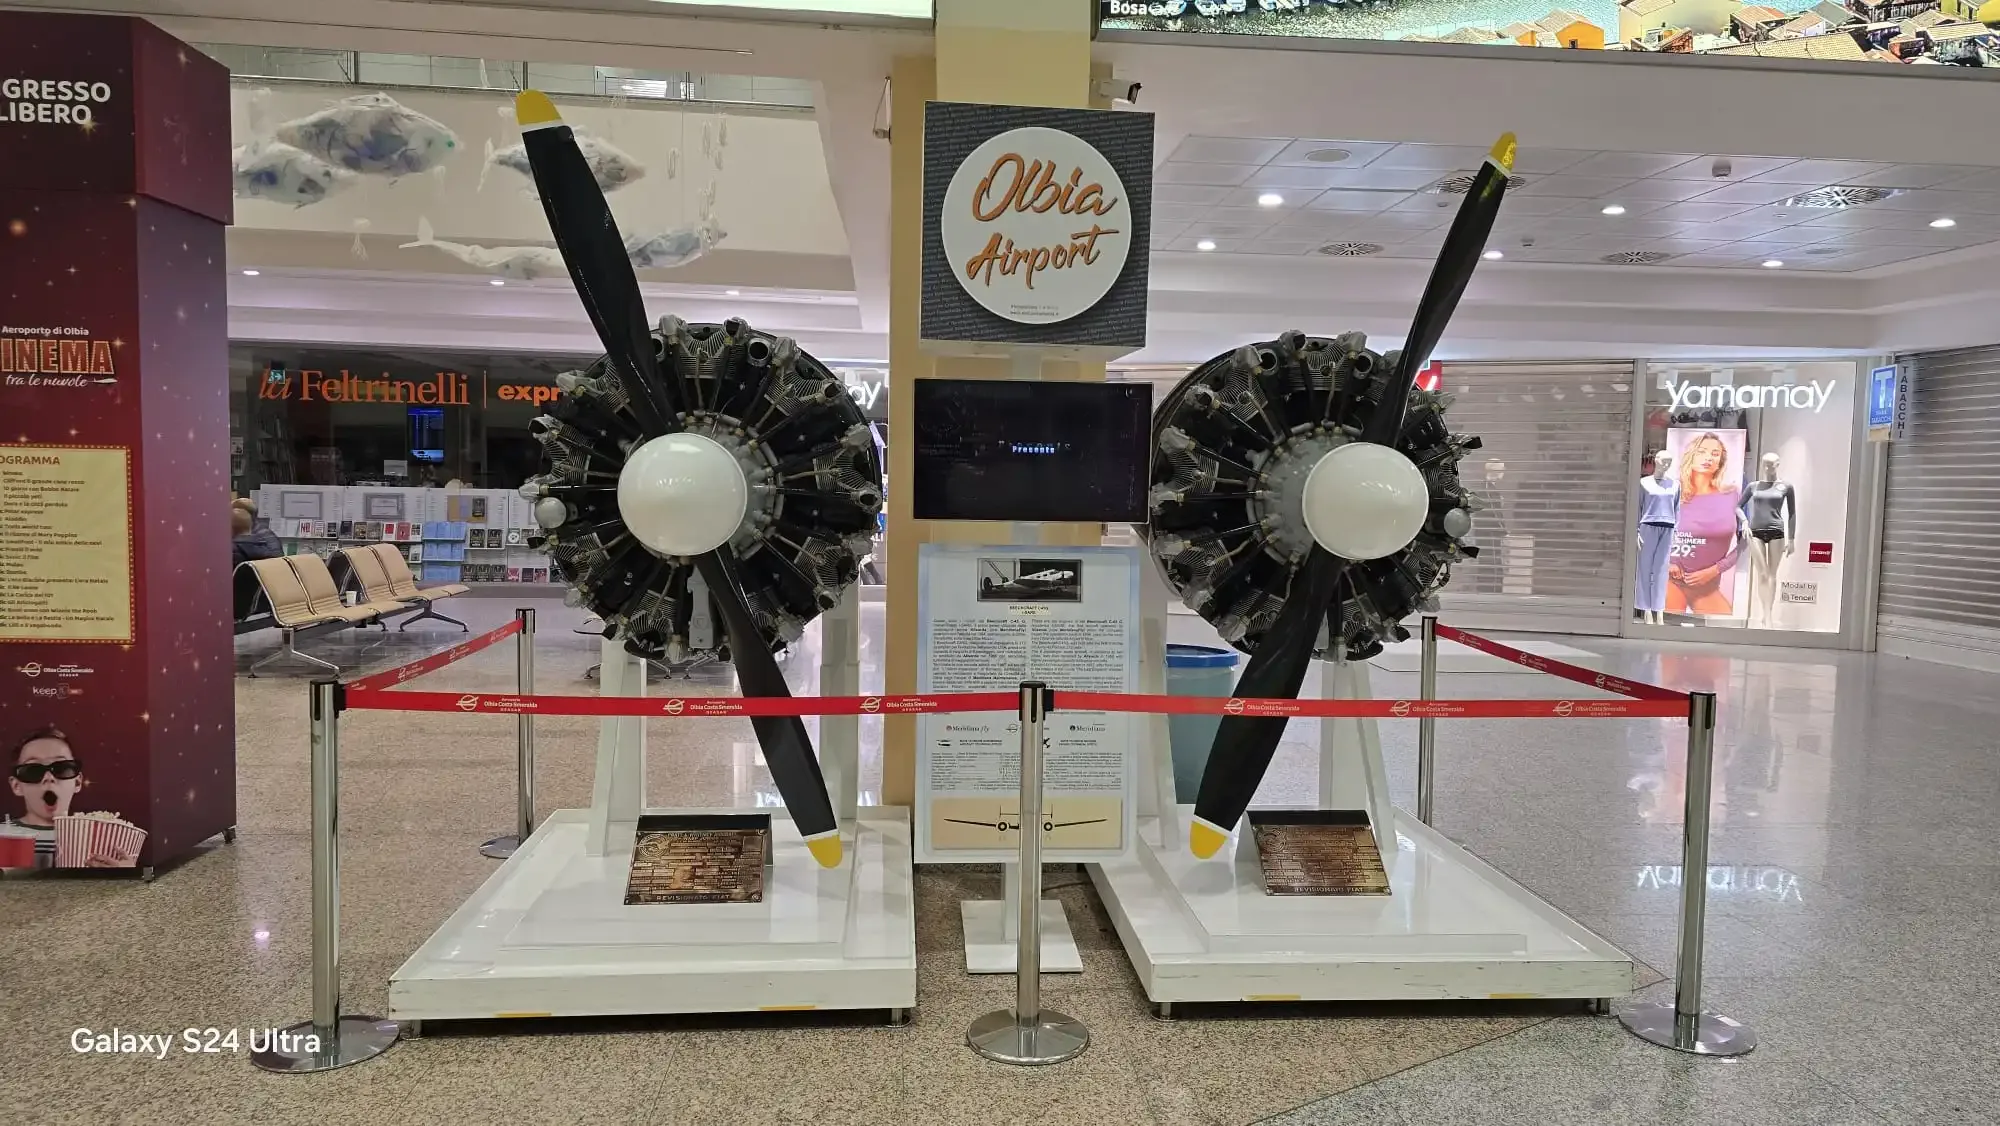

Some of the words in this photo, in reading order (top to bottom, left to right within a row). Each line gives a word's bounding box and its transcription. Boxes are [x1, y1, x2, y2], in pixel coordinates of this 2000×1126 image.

[1111, 0, 1147, 15] Bosa
[2, 78, 111, 103] GRESSO
[971, 152, 1118, 222] Olbia
[965, 223, 1120, 290] Airport
[2, 326, 51, 336] Aeroporto
[52, 326, 62, 335] di
[64, 327, 89, 336] Olbia
[1, 338, 114, 374] INEMA
[6, 375, 25, 386] tra
[28, 373, 41, 386] le
[300, 369, 470, 406] Feltrinelli
[497, 383, 561, 407] expr
[1665, 379, 1836, 413] yamamay
[1897, 366, 1909, 439] TABACCHI
[0, 455, 60, 465] OGRAMMA
[1670, 544, 1692, 557] 29
